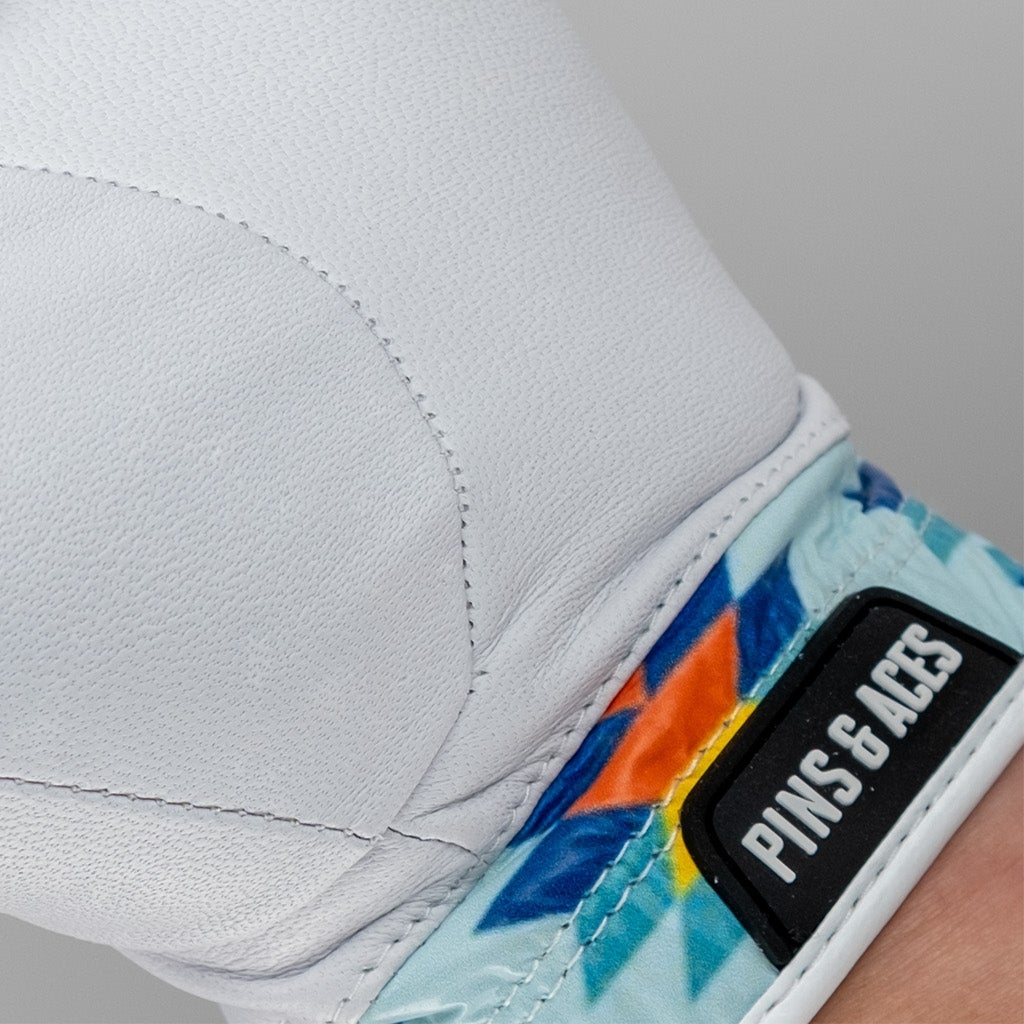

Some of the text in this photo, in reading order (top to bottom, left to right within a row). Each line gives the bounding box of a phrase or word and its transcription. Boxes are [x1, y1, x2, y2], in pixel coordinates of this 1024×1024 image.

[741, 624, 962, 883] PINS & ACES
